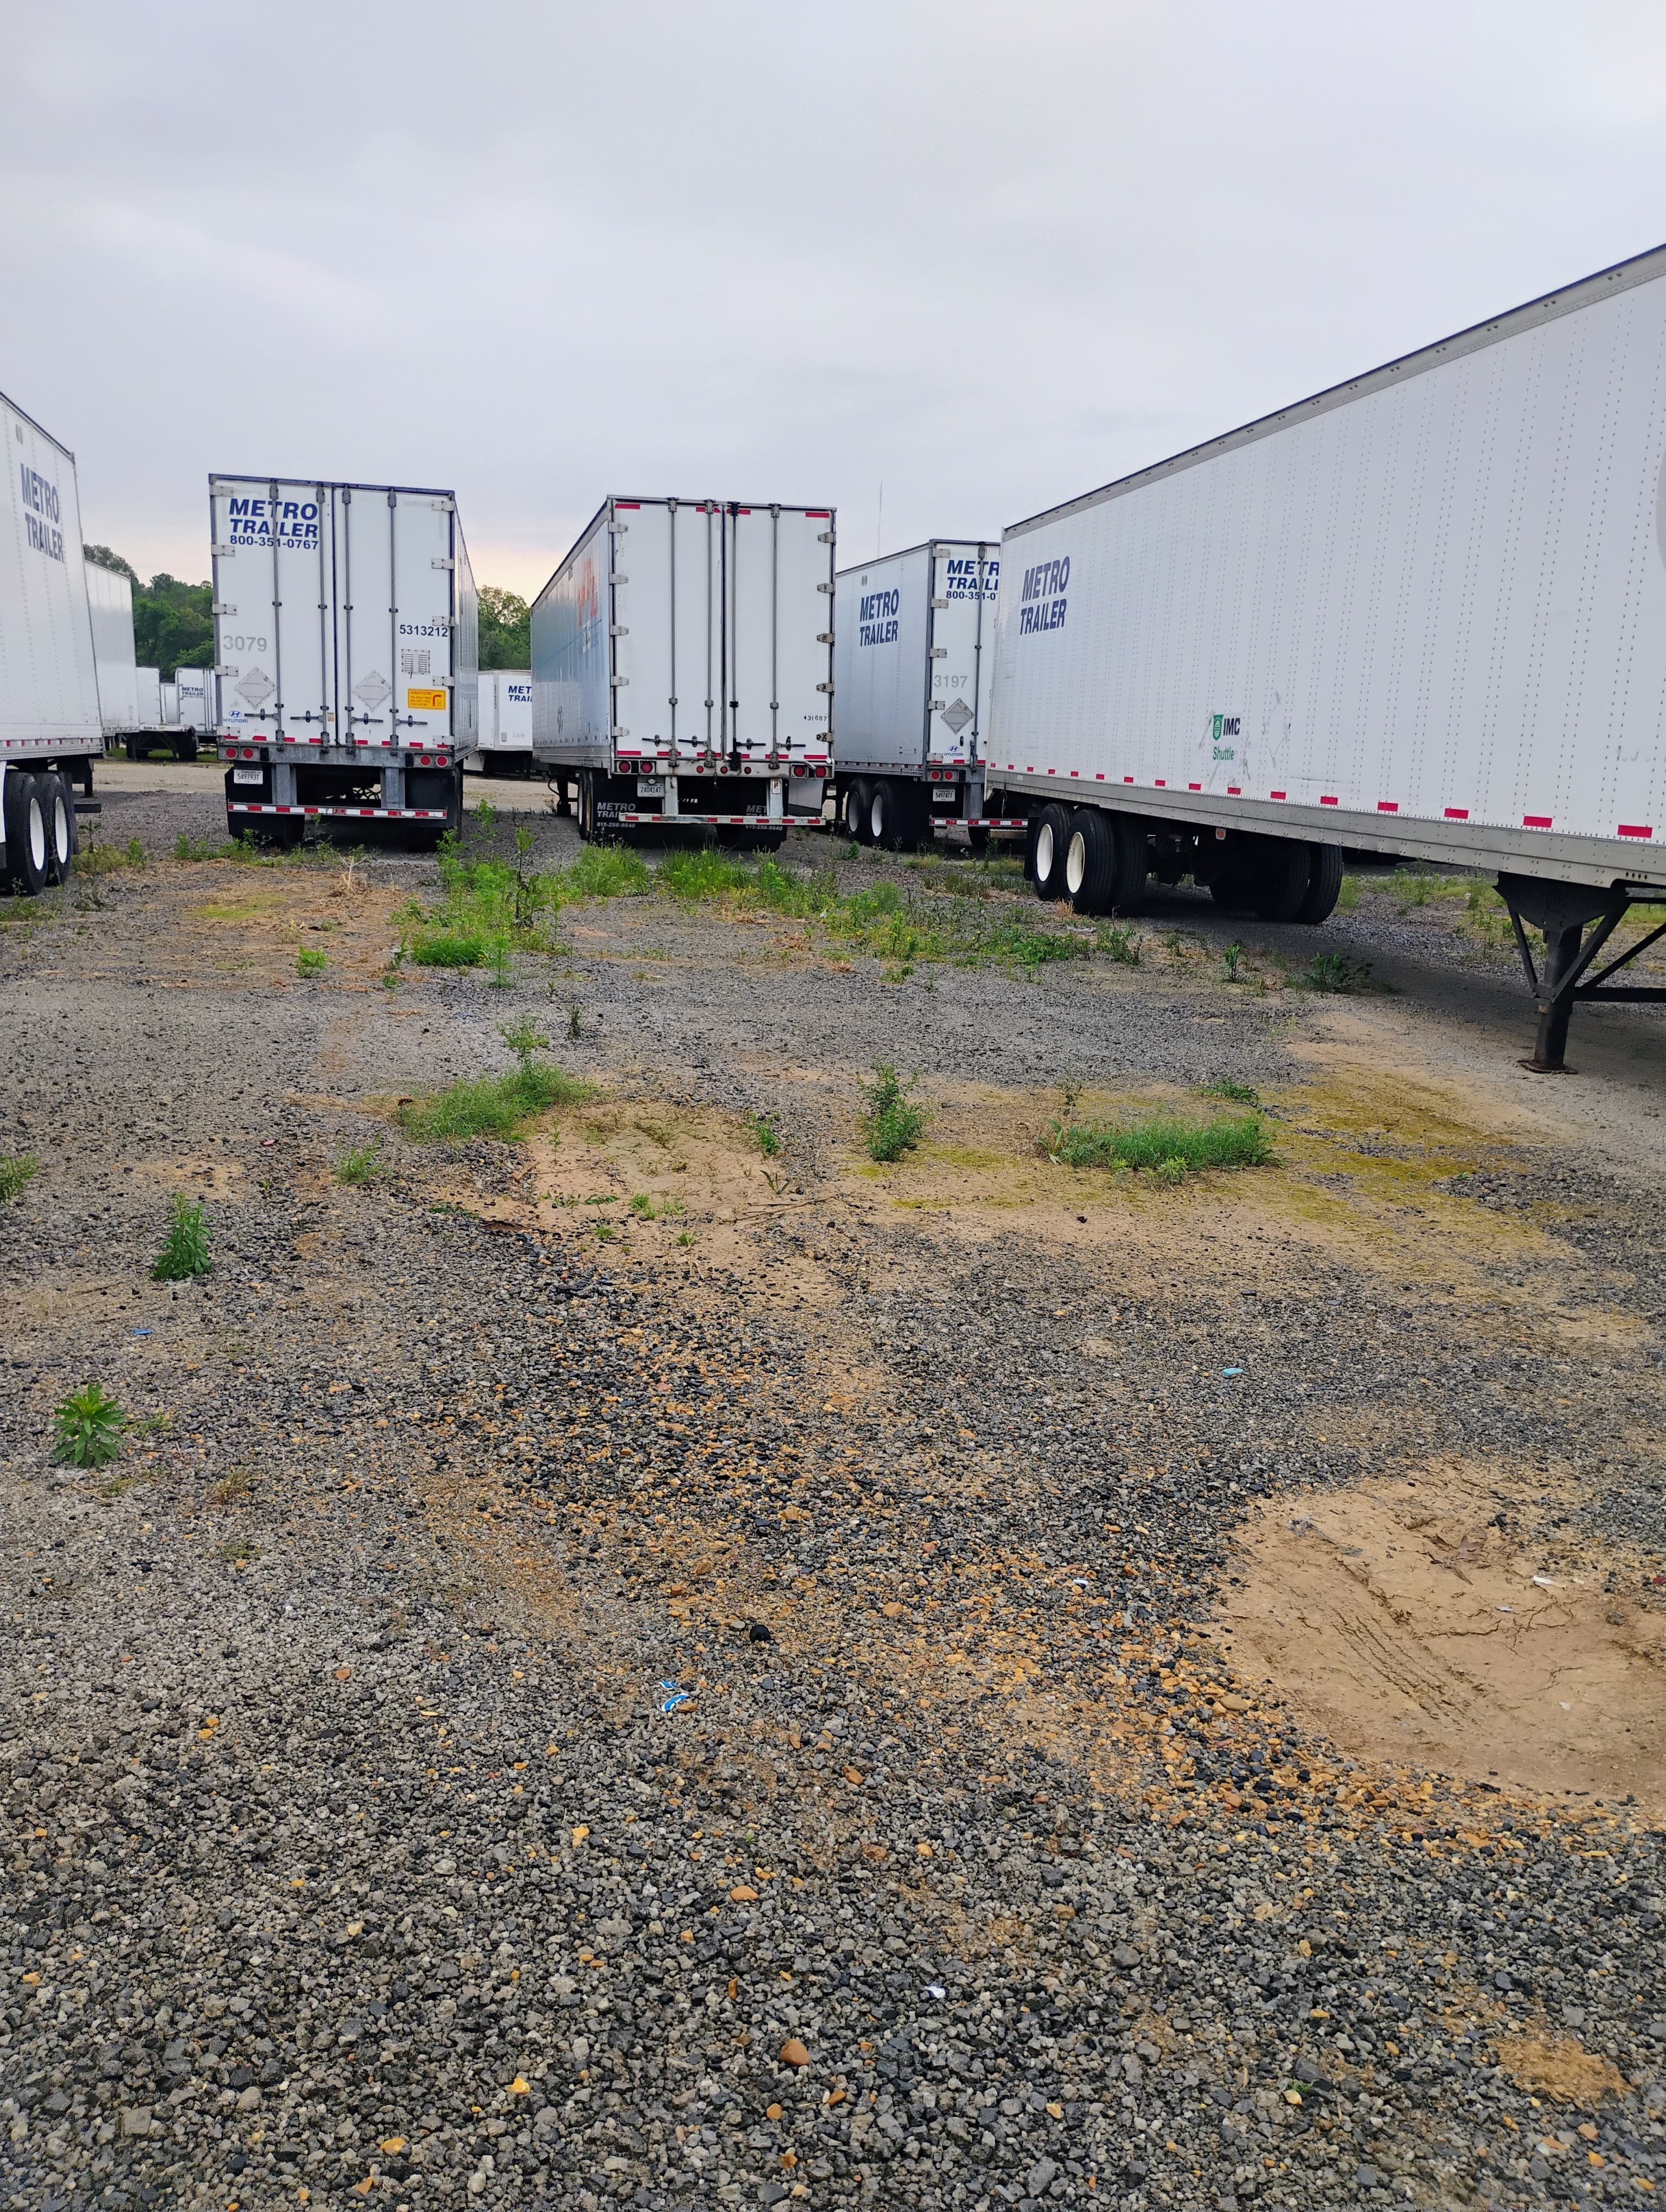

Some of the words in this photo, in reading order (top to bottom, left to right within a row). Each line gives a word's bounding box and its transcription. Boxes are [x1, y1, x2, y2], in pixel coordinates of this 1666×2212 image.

[20, 462, 60, 524] METRO
[229, 498, 318, 521] METRO
[25, 512, 64, 563] TRAILER
[230, 518, 319, 538] TRALER
[230, 535, 319, 550] 800-351-0767
[1022, 556, 1071, 602] METRO
[946, 590, 998, 600] 800-351-0
[860, 588, 899, 622] METRO
[1020, 598, 1067, 635] TRAILER
[399, 625, 448, 637] 5313212
[860, 620, 899, 647] TRAILER
[223, 635, 267, 652] 3079
[933, 675, 968, 688] 3197
[1223, 717, 1241, 736] IMC
[1213, 745, 1234, 761] Shuttle
[597, 802, 636, 812] METRO
